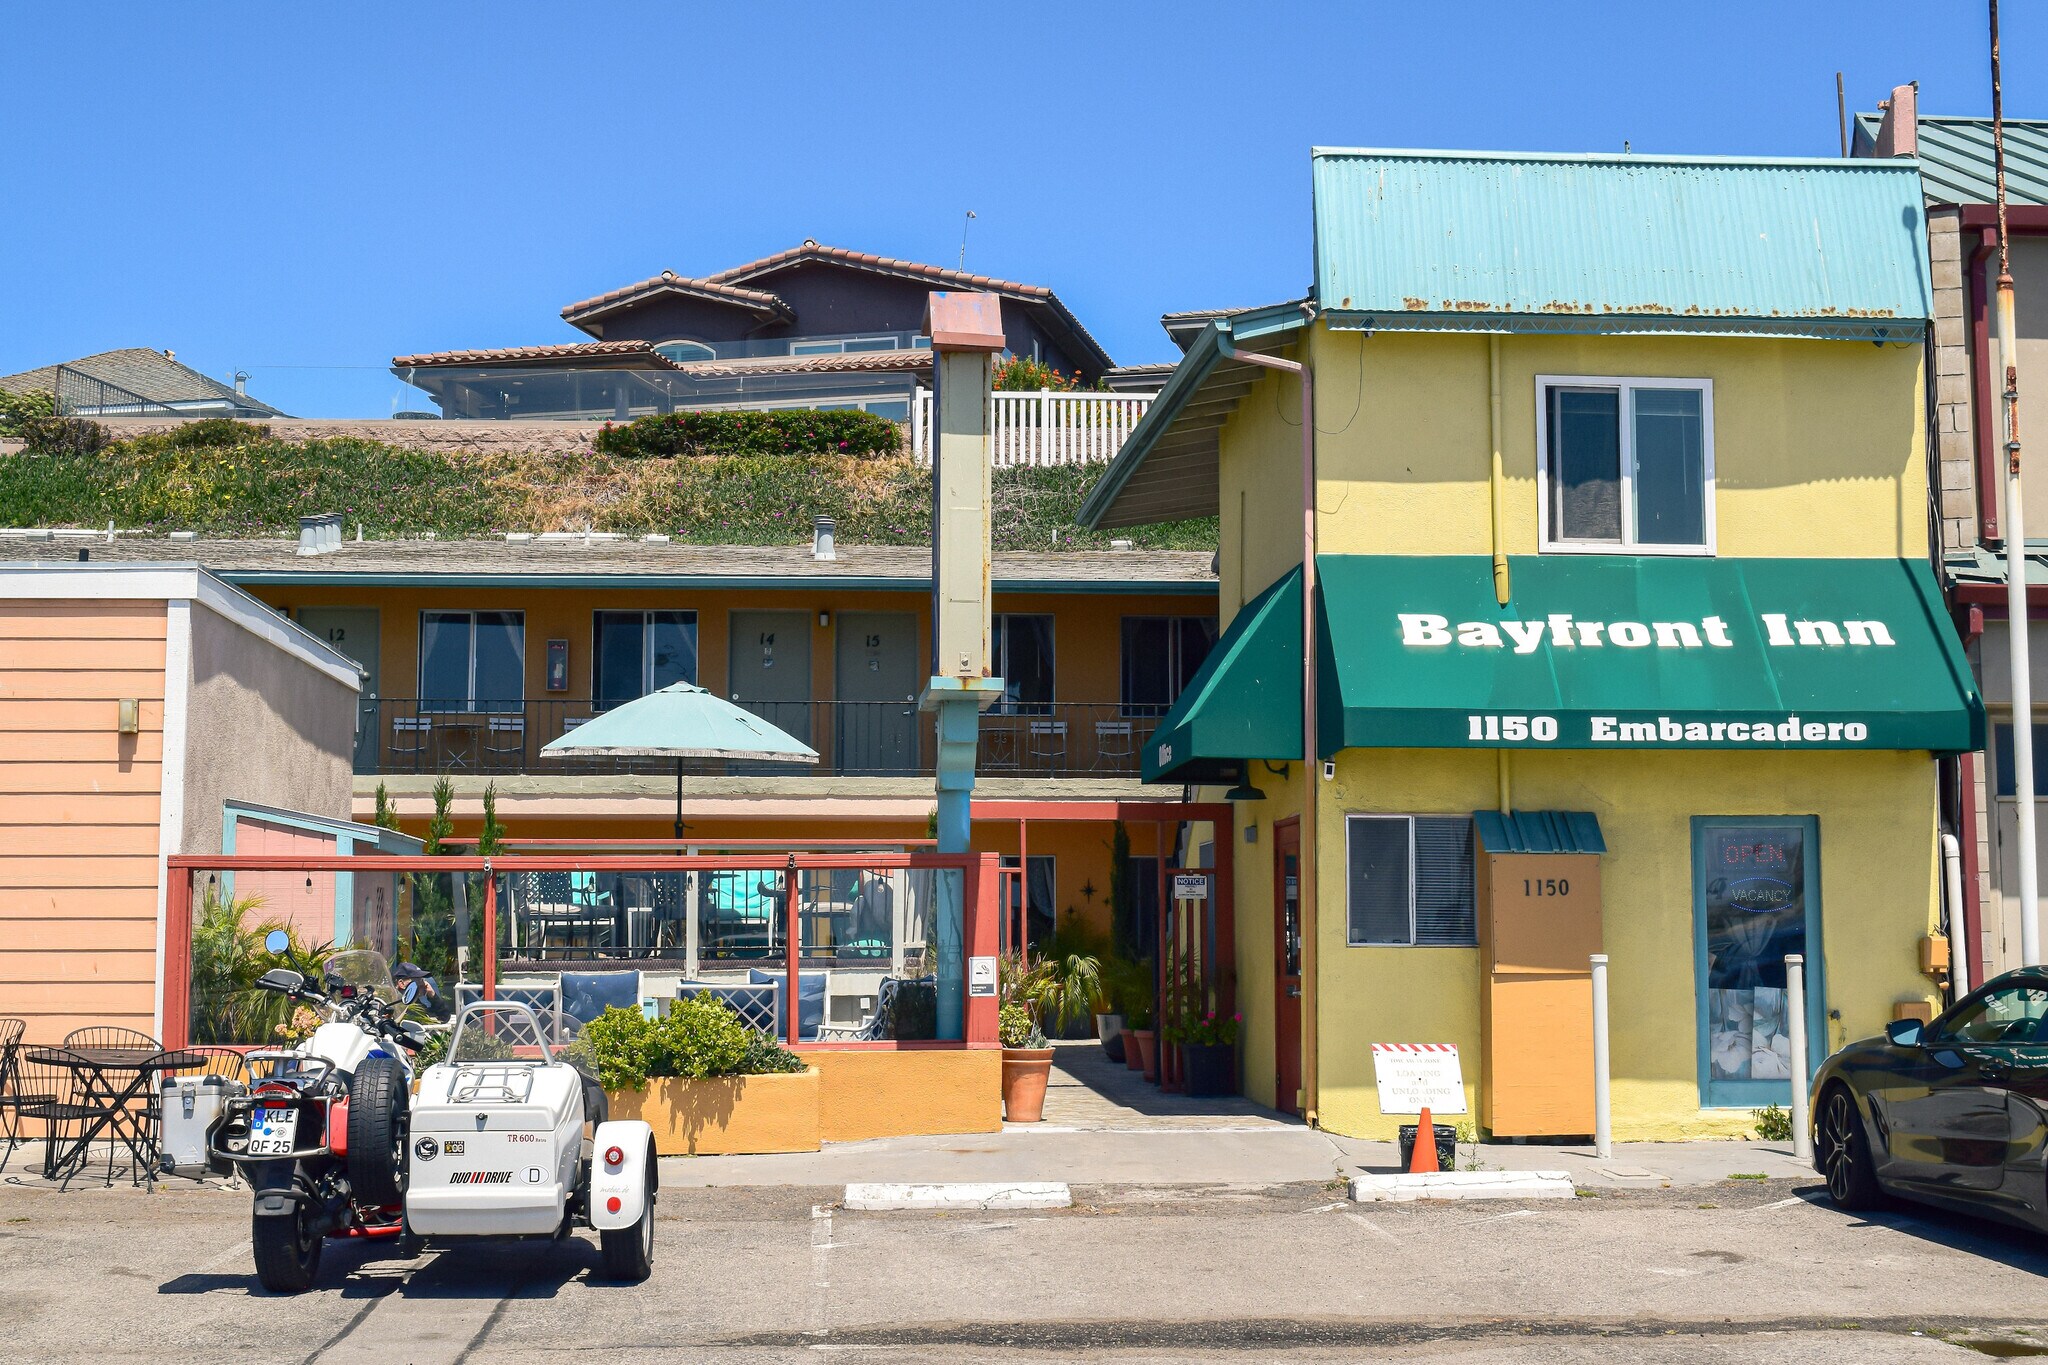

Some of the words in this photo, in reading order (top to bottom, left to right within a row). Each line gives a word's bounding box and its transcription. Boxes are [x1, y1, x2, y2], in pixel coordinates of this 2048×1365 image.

[329, 628, 345, 641] 12
[760, 632, 775, 645] 14
[1397, 612, 1733, 654] Bayfront
[1761, 612, 1896, 646] Inn
[866, 634, 880, 647] 15
[1468, 716, 1558, 742] 1150
[1590, 715, 1868, 742] Embarcadero
[1725, 844, 1783, 864] OPEN
[1523, 879, 1569, 896] 1150
[1731, 889, 1792, 902] VACANCY
[265, 1110, 294, 1123] KLE
[507, 1134, 518, 1143] TR
[519, 1134, 535, 1143] 600
[251, 1140, 270, 1152] QF
[272, 1140, 291, 1153] 25
[484, 1171, 513, 1184] DRIVE
[529, 1168, 540, 1183] D
